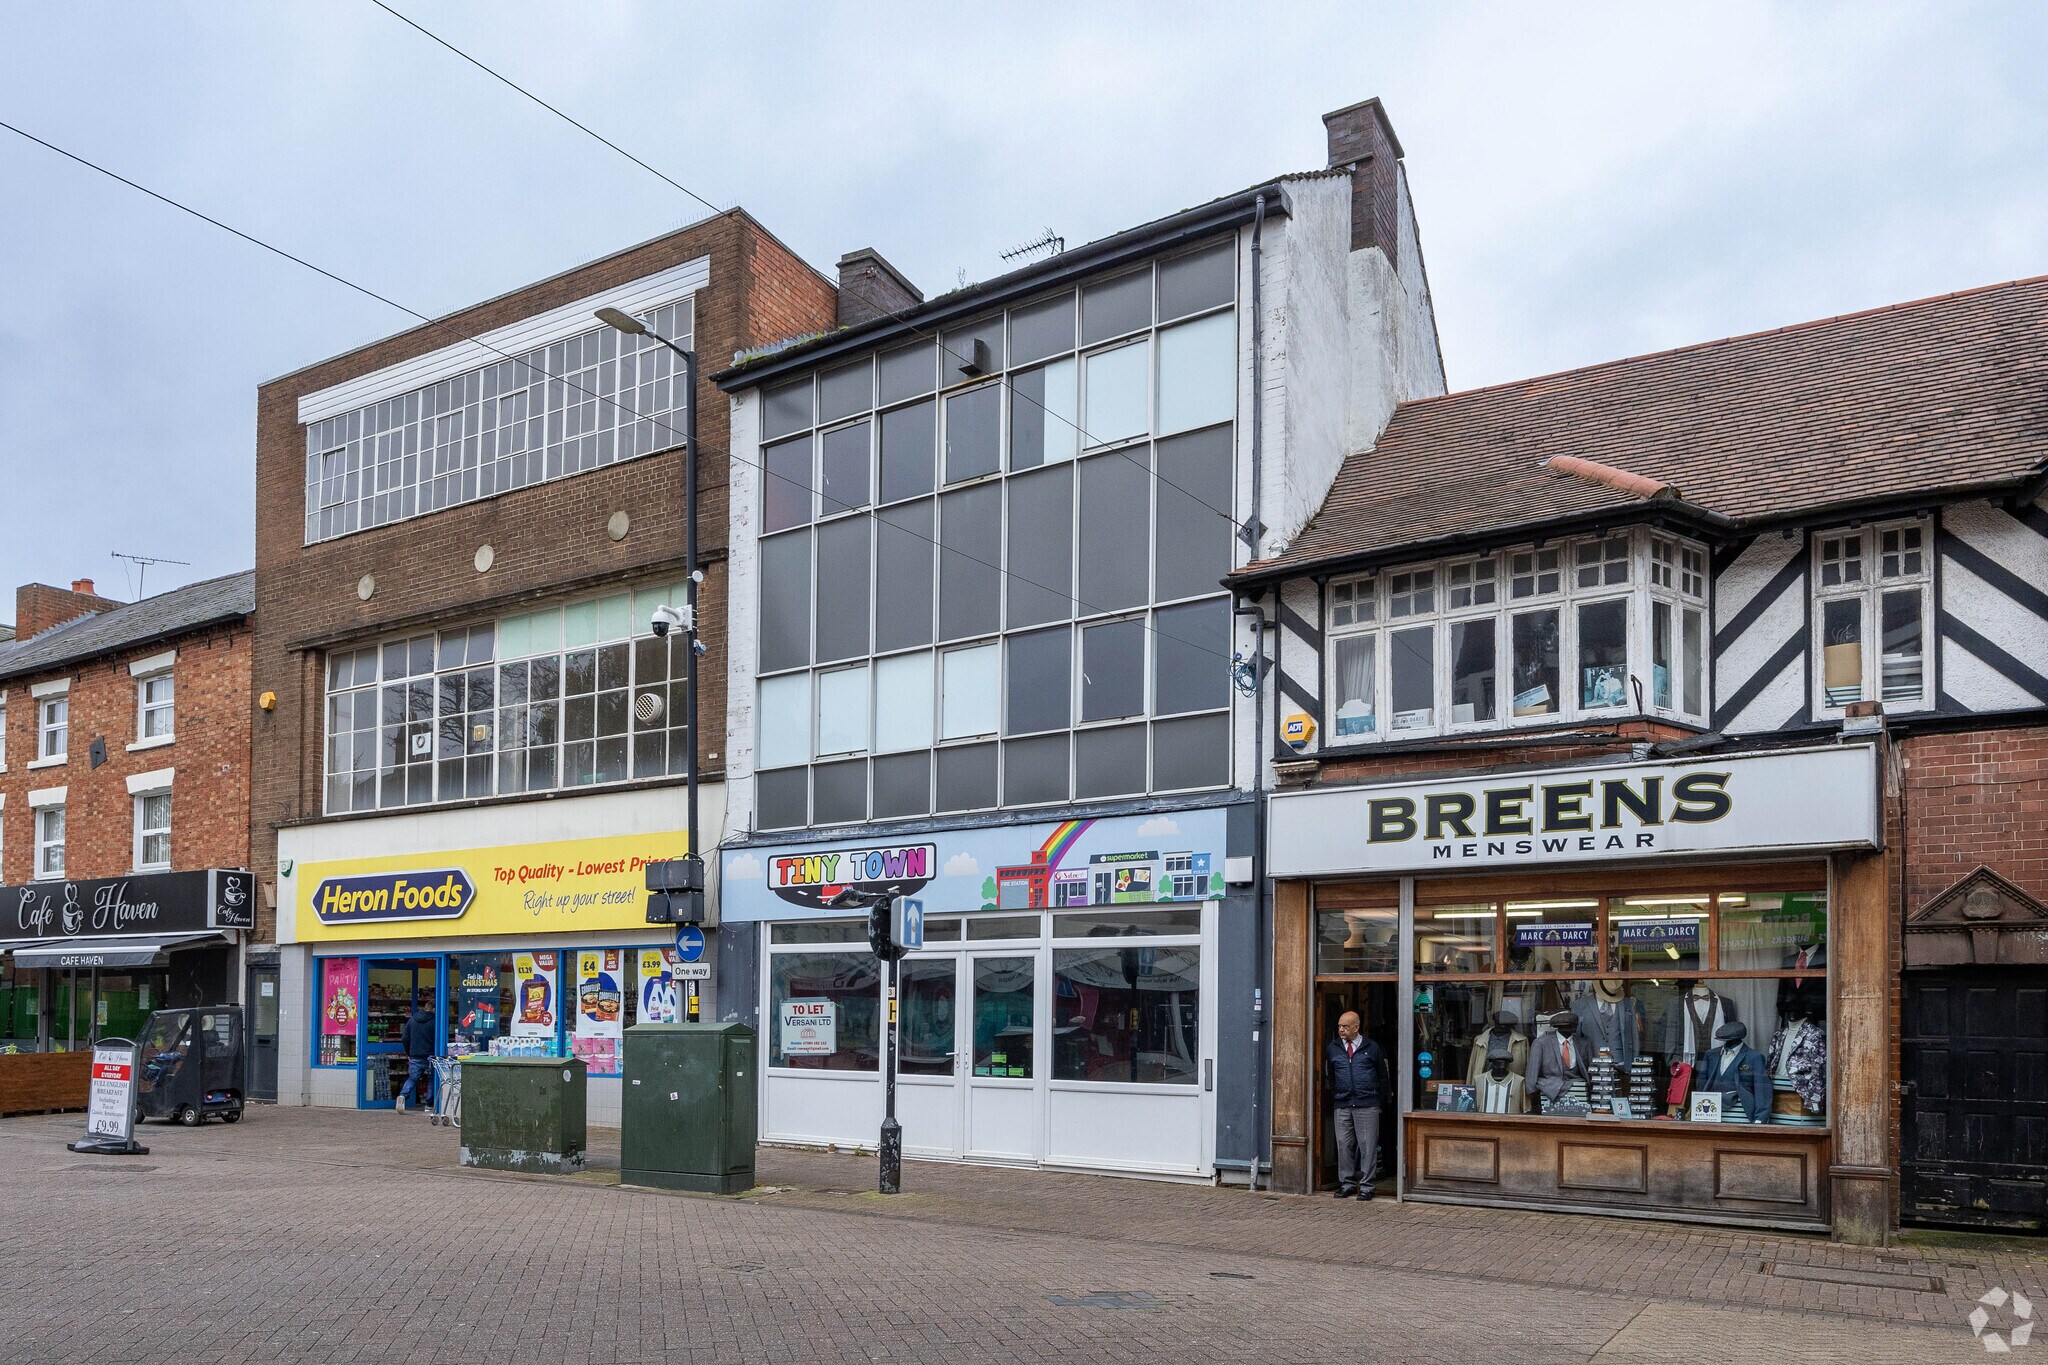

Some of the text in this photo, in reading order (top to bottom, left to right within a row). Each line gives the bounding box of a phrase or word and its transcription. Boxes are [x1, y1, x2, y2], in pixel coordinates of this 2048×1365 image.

[1288, 722, 1303, 732] ADT
[1366, 772, 1732, 844] BREENS
[1433, 833, 1655, 859] MENSWEAR
[1106, 851, 1148, 862] supermarket
[493, 867, 516, 884] Top
[518, 862, 564, 884] Quality
[577, 859, 625, 876] Lowest
[777, 847, 926, 886] TINY TOWN
[1011, 879, 1028, 887] STATION
[320, 875, 463, 915] Heron Foods
[523, 886, 636, 916] Right up your street!
[18, 881, 158, 937] Cafe Haven
[217, 904, 232, 918] Cafe
[225, 912, 251, 923] Haven
[1520, 930, 1588, 940] MARC DARCY
[1622, 926, 1695, 938] MARC DARCY
[60, 955, 104, 966] CAFE HAVEN
[583, 960, 596, 971] £4
[642, 960, 660, 969] £3.99
[518, 966, 532, 974] £1.29
[675, 967, 708, 976] One way
[328, 973, 357, 986] PARTY!
[462, 979, 498, 988] CHRISTMAS
[690, 998, 699, 1012] H
[792, 1005, 824, 1015] TO LET
[784, 1016, 831, 1026] VERSANI LTD
[106, 1081, 128, 1089] ENGLISH
[96, 1088, 123, 1096] BREAKFAST
[95, 1119, 119, 1133] £9.99
